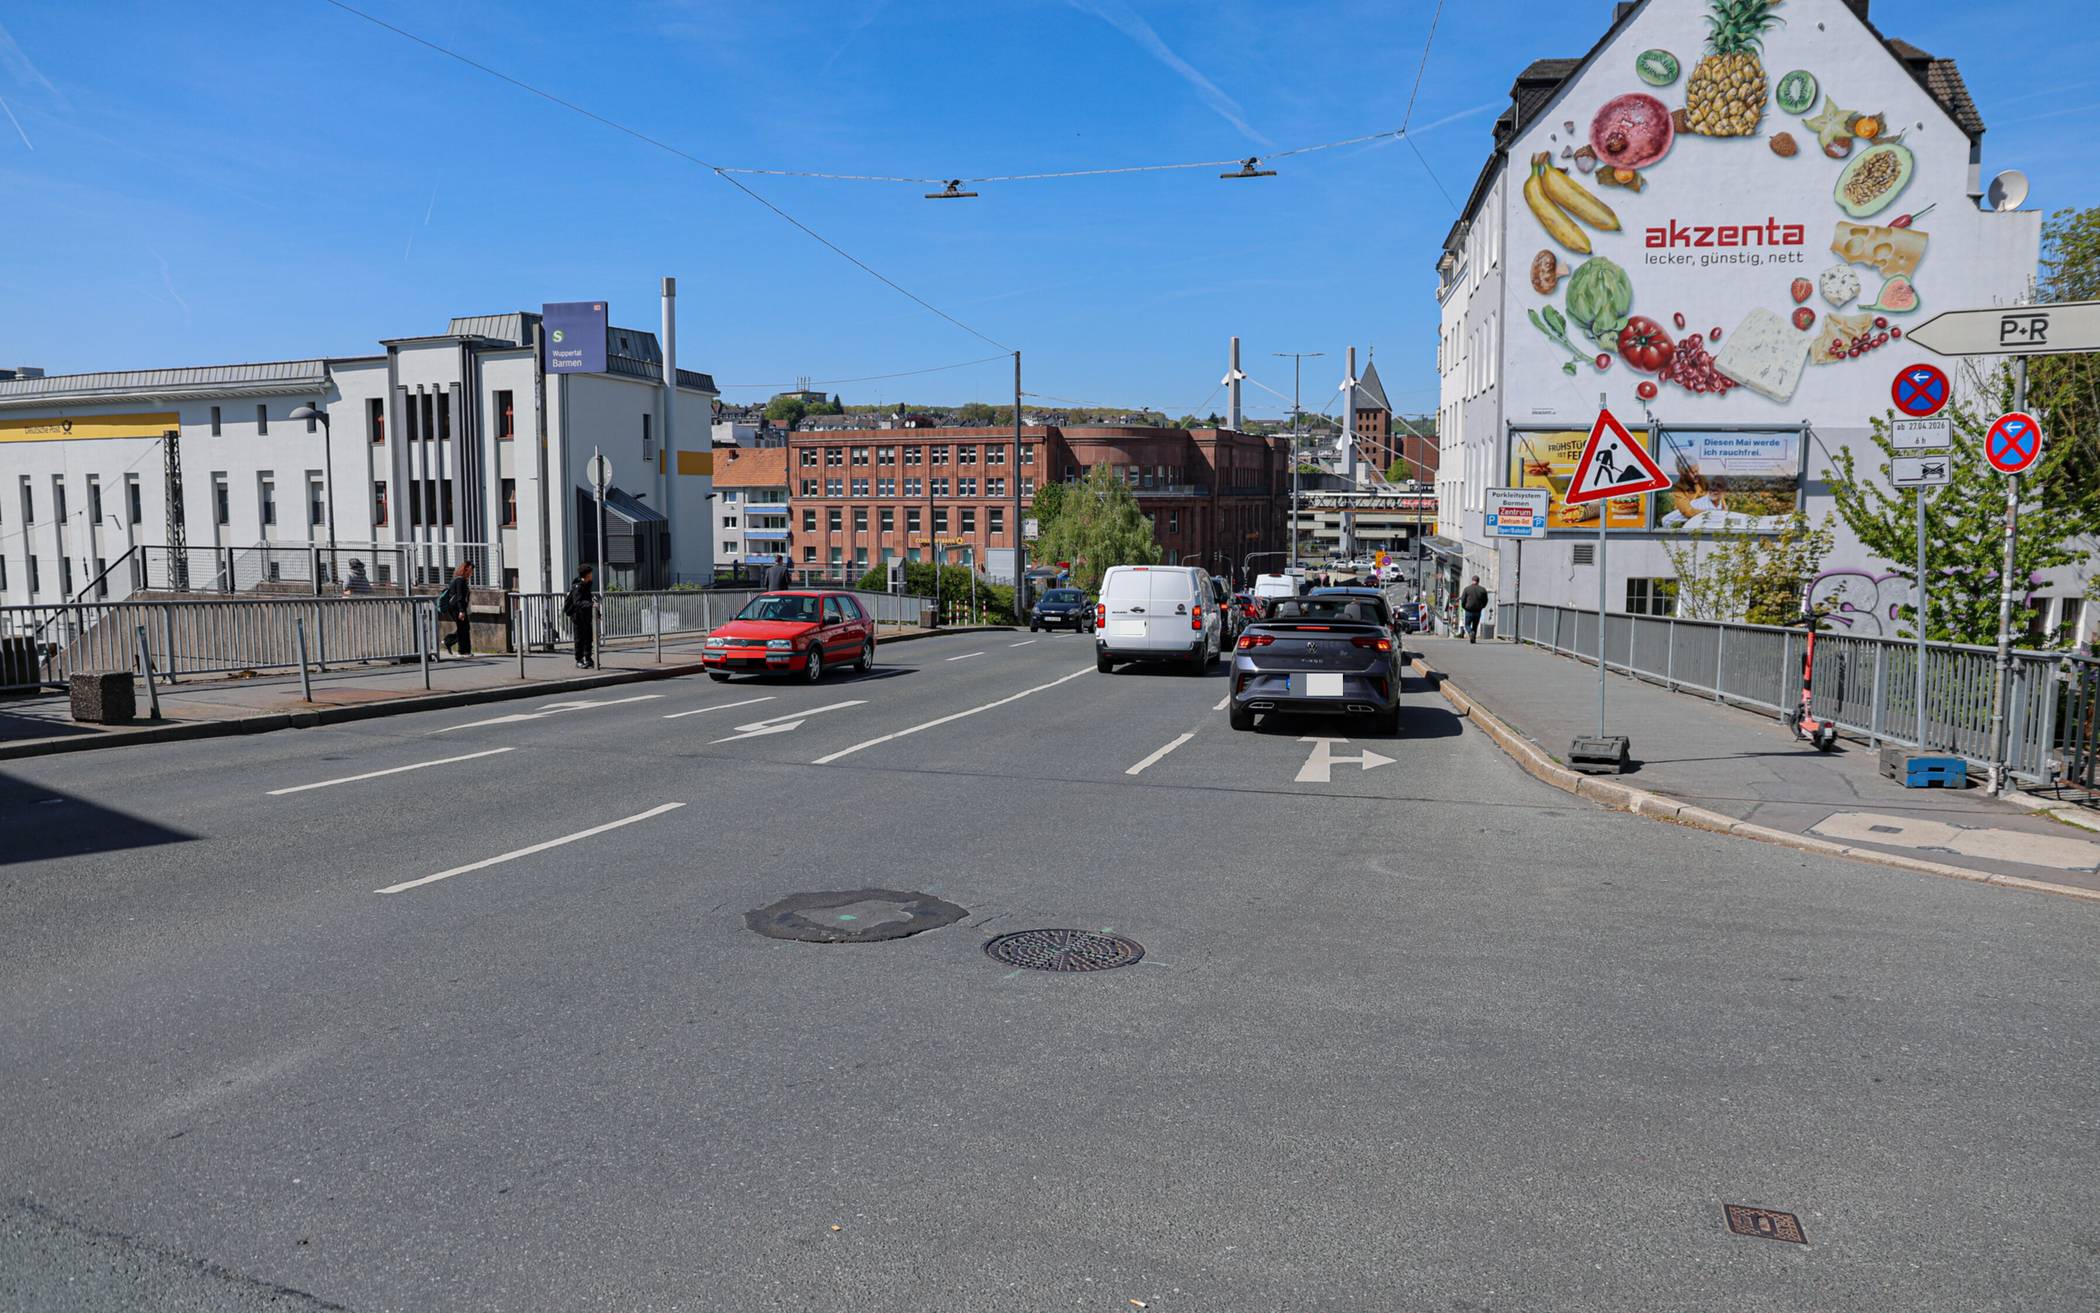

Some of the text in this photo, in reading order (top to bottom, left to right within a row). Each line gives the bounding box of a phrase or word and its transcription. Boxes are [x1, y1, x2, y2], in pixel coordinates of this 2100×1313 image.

[1645, 216, 1804, 248] akzenta
[1645, 251, 1804, 267] lecker, günstig, nett
[2000, 318, 2048, 342] P+R
[553, 330, 562, 343] S
[552, 350, 582, 358] Wuppertal
[552, 359, 582, 368] Barmen
[1704, 438, 1780, 447] Diesen Mai werde
[1704, 449, 1762, 457] ich rauchfrei.
[1492, 491, 1541, 500] Parkleitsystem
[1500, 508, 1531, 516] Zentrum
